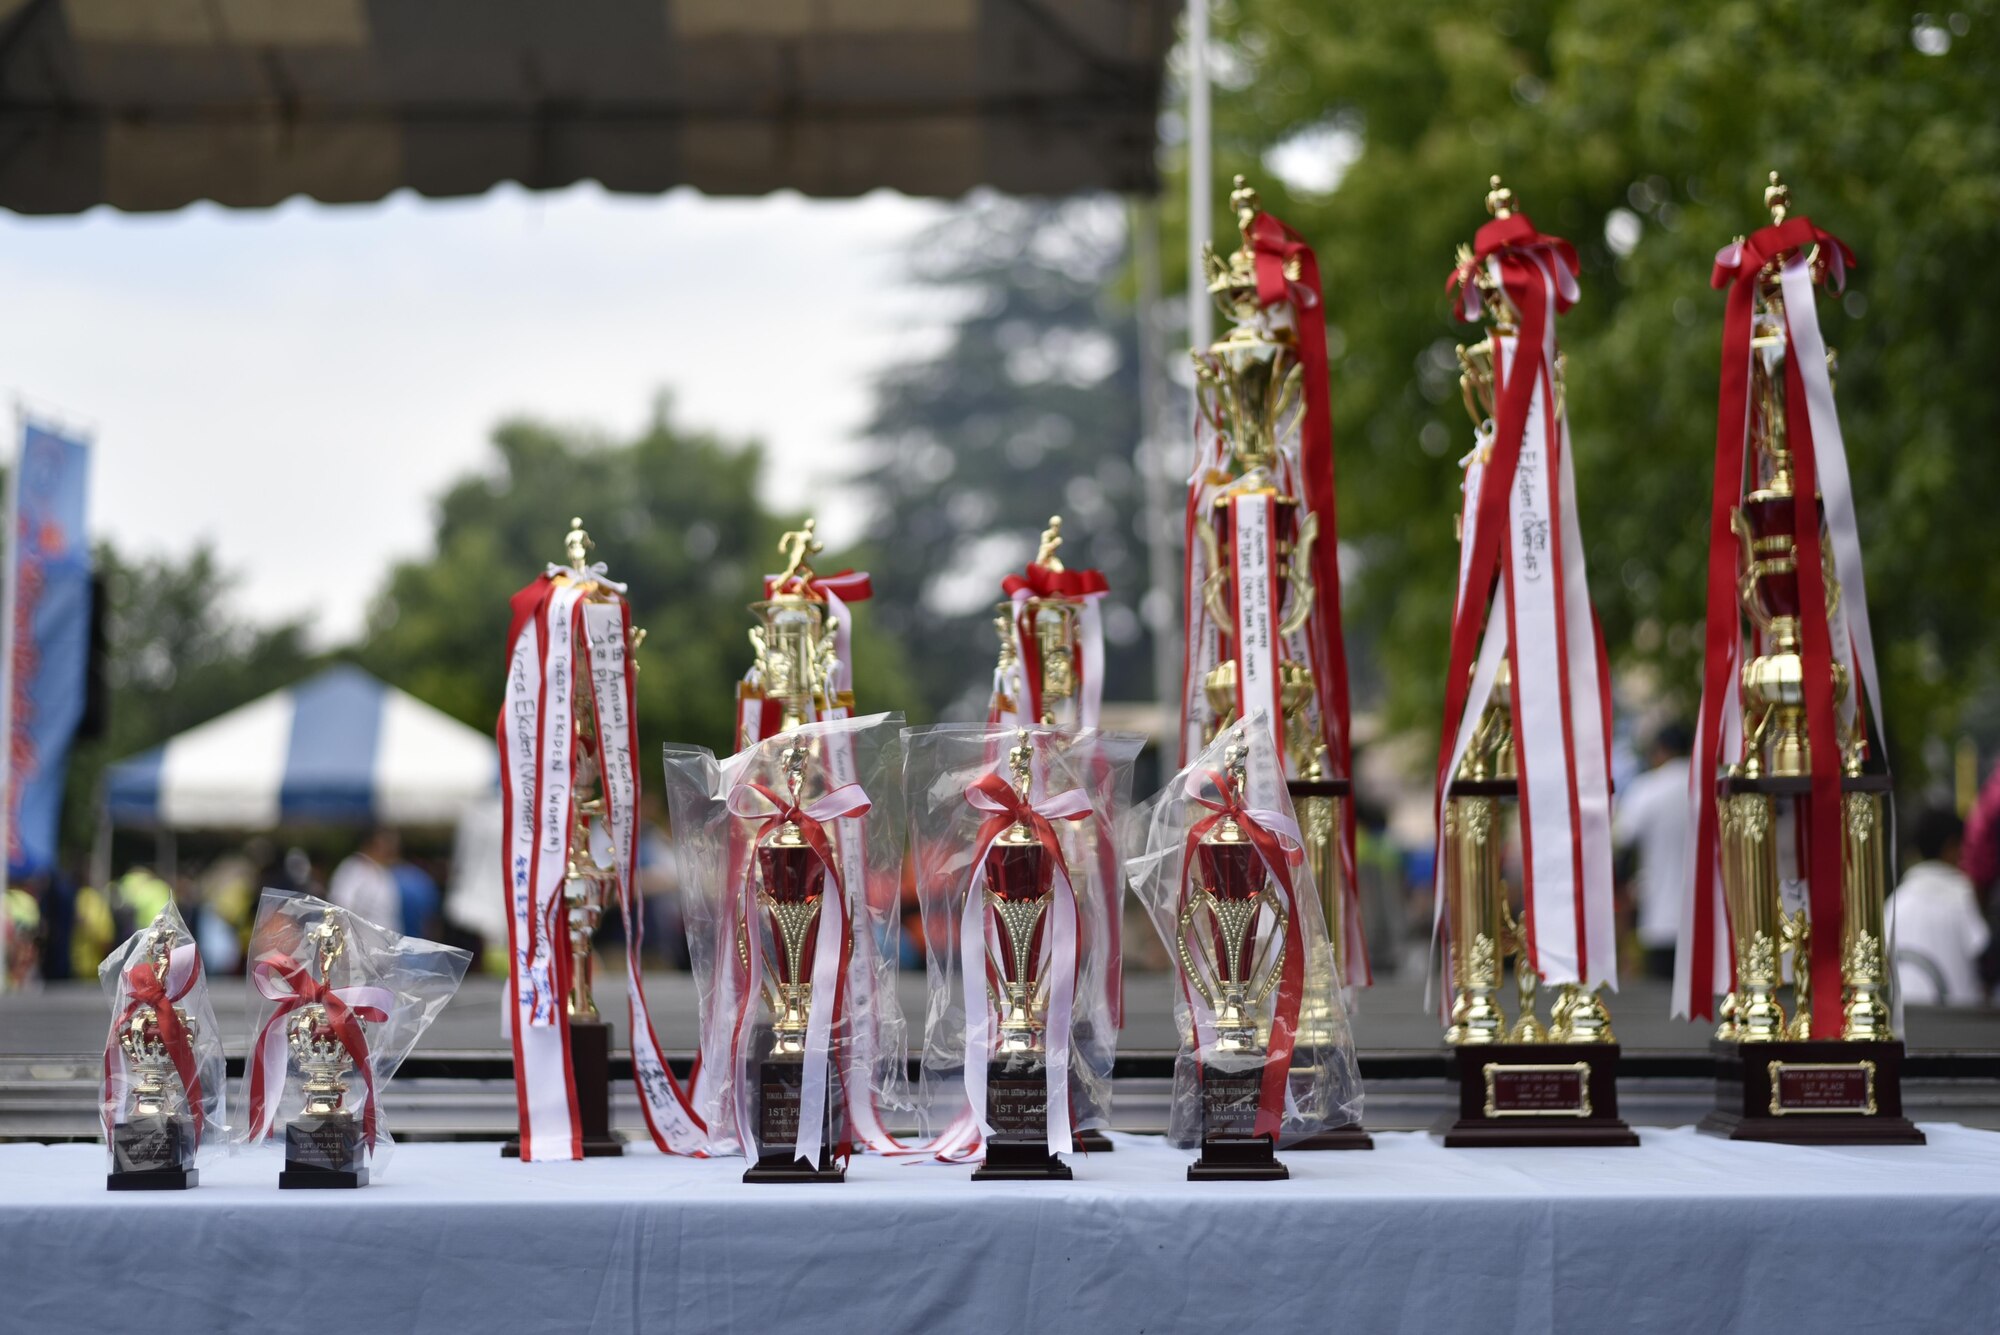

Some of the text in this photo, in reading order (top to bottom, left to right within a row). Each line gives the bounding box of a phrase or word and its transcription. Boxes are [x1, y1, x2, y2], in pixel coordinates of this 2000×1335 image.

[555, 655, 567, 704] YOKOTA
[591, 668, 606, 716] Place
[607, 669, 627, 730] Annual
[515, 699, 536, 758] Ekiden
[551, 713, 566, 773] EKIDEN
[617, 745, 633, 794] Yokota
[542, 783, 566, 856] (WOMEN)
[623, 803, 635, 857] Ekiden
[768, 1107, 785, 1116] 1ST
[996, 1104, 1013, 1113] 1ST
[1211, 1103, 1257, 1112] 1ST PLAC
